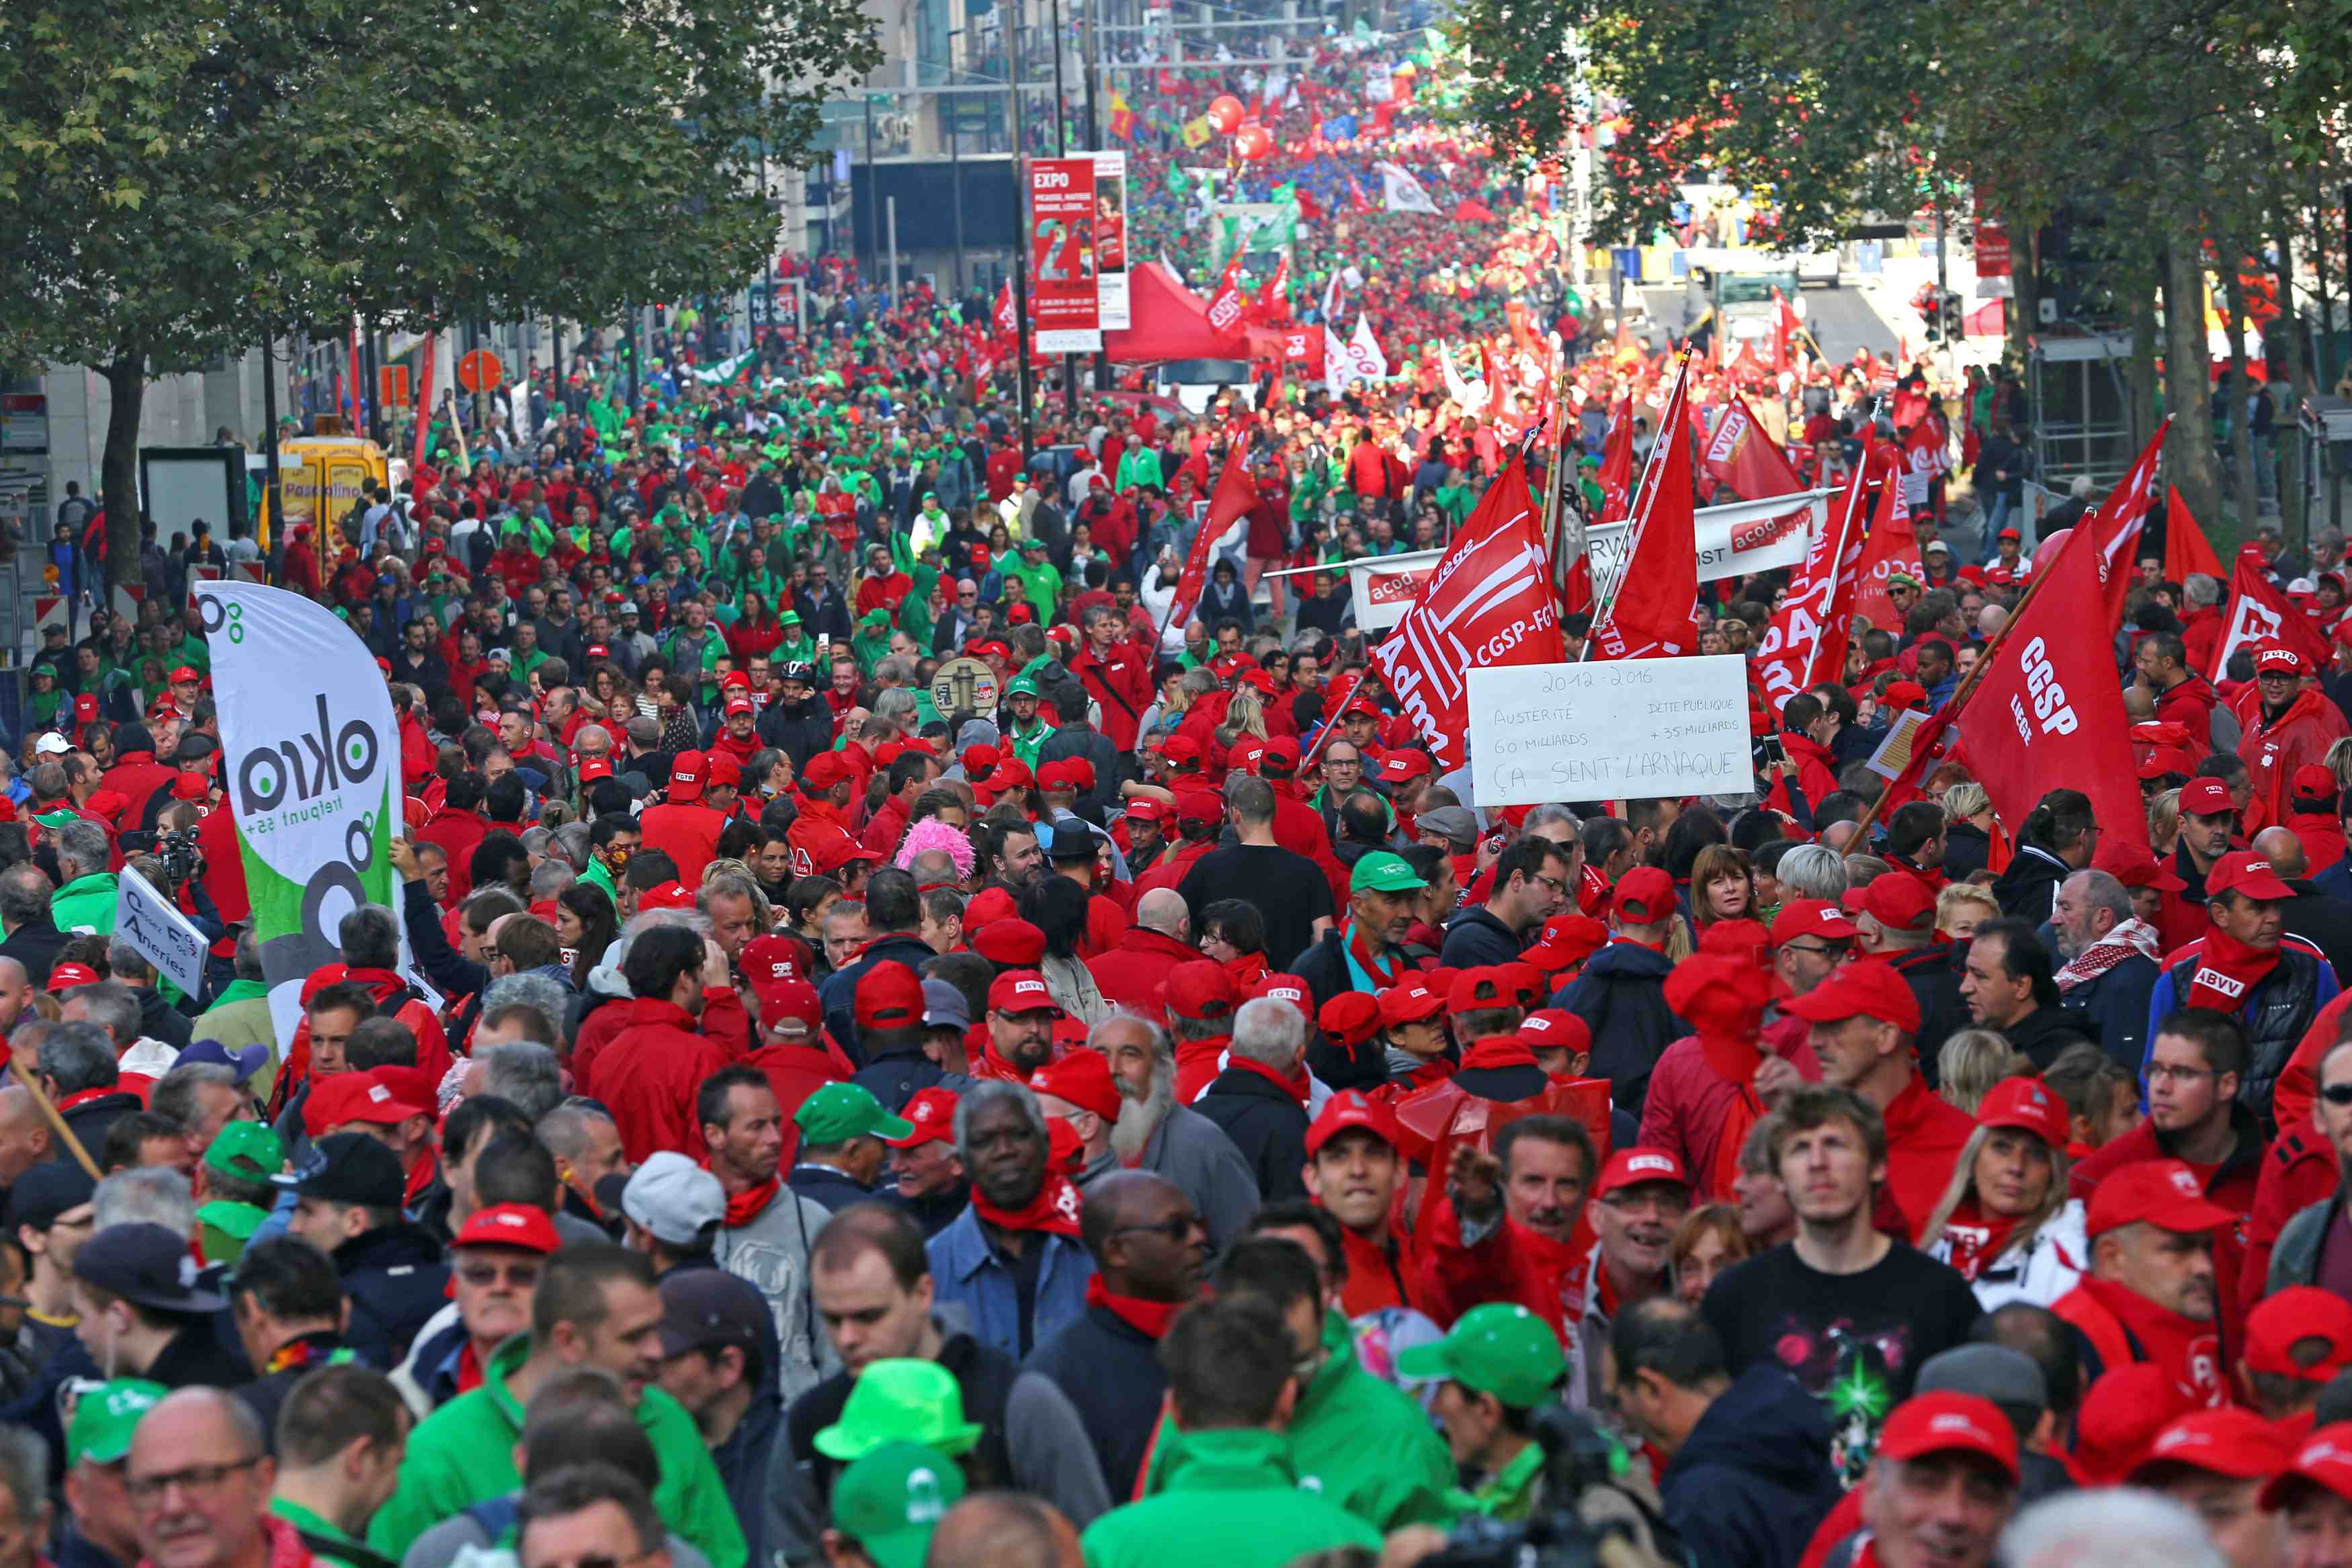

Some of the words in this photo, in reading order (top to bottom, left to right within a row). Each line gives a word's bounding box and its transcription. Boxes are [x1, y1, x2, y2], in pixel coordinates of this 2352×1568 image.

[1033, 172, 1069, 188] EXPO
[1734, 517, 1776, 549] acod
[1429, 538, 1474, 596] Liège
[1371, 571, 1414, 601] acod
[2262, 650, 2298, 664] FGTB
[1542, 672, 1593, 693] 2012
[2021, 636, 2078, 736] CGSP
[978, 688, 994, 700] cgt
[1647, 701, 1681, 715] DETTE
[1683, 698, 1734, 711] PUBLIQUE
[1663, 726, 1681, 740] 35
[1685, 720, 1740, 736] MILLIARDS
[2010, 693, 2033, 747] LIEGE
[1495, 738, 1518, 754] 60
[1524, 732, 1589, 750] MILLIARDS
[1249, 749, 1263, 760] FGT
[677, 773, 694, 781] FGTB
[1495, 763, 1526, 797] ÇA
[1551, 756, 1615, 785] SENT
[1625, 750, 1737, 780] L'ARNAQUE
[2194, 967, 2244, 998] ABVV
